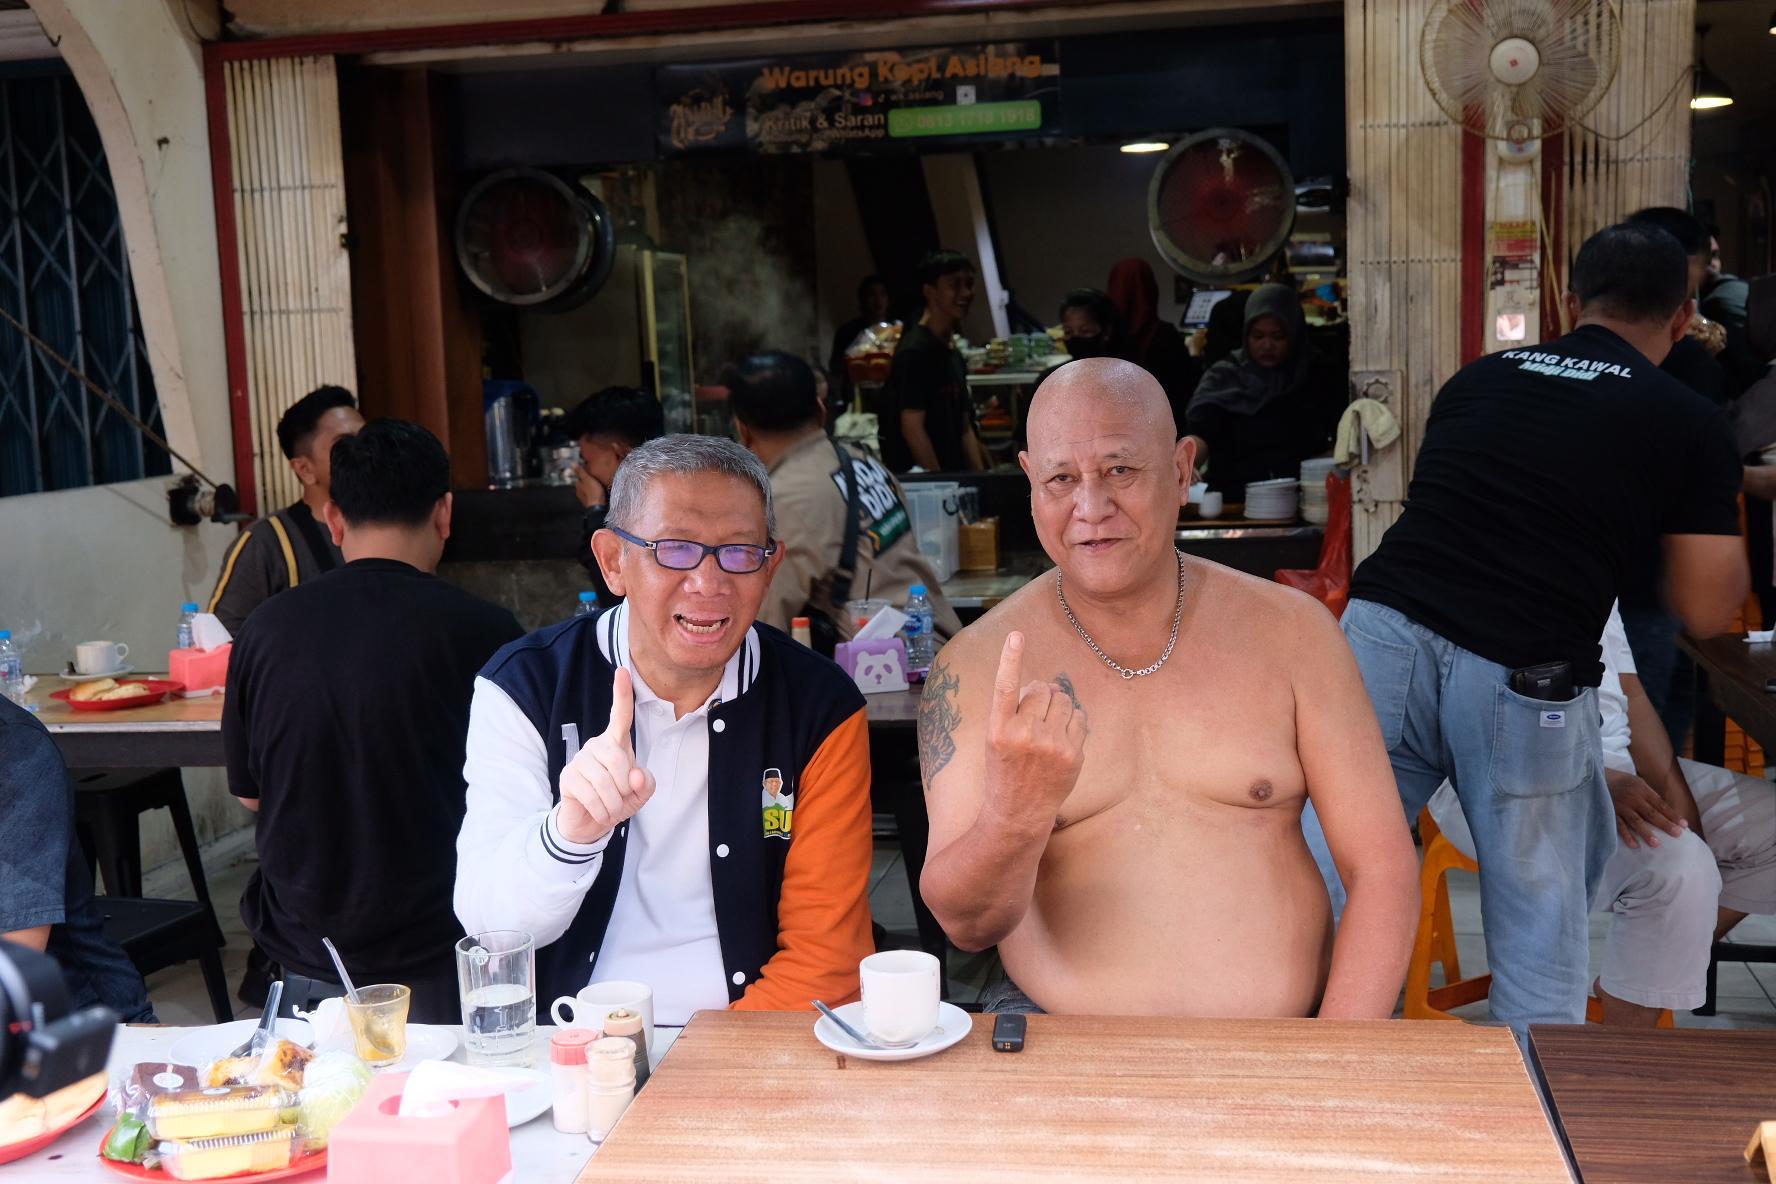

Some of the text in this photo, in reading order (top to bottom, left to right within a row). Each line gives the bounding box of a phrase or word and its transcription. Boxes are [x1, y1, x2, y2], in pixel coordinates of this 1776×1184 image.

[761, 64, 872, 90] Warung
[815, 111, 829, 129] &
[834, 111, 885, 128] Saran
[1501, 350, 1633, 378] KANG KAWAL
